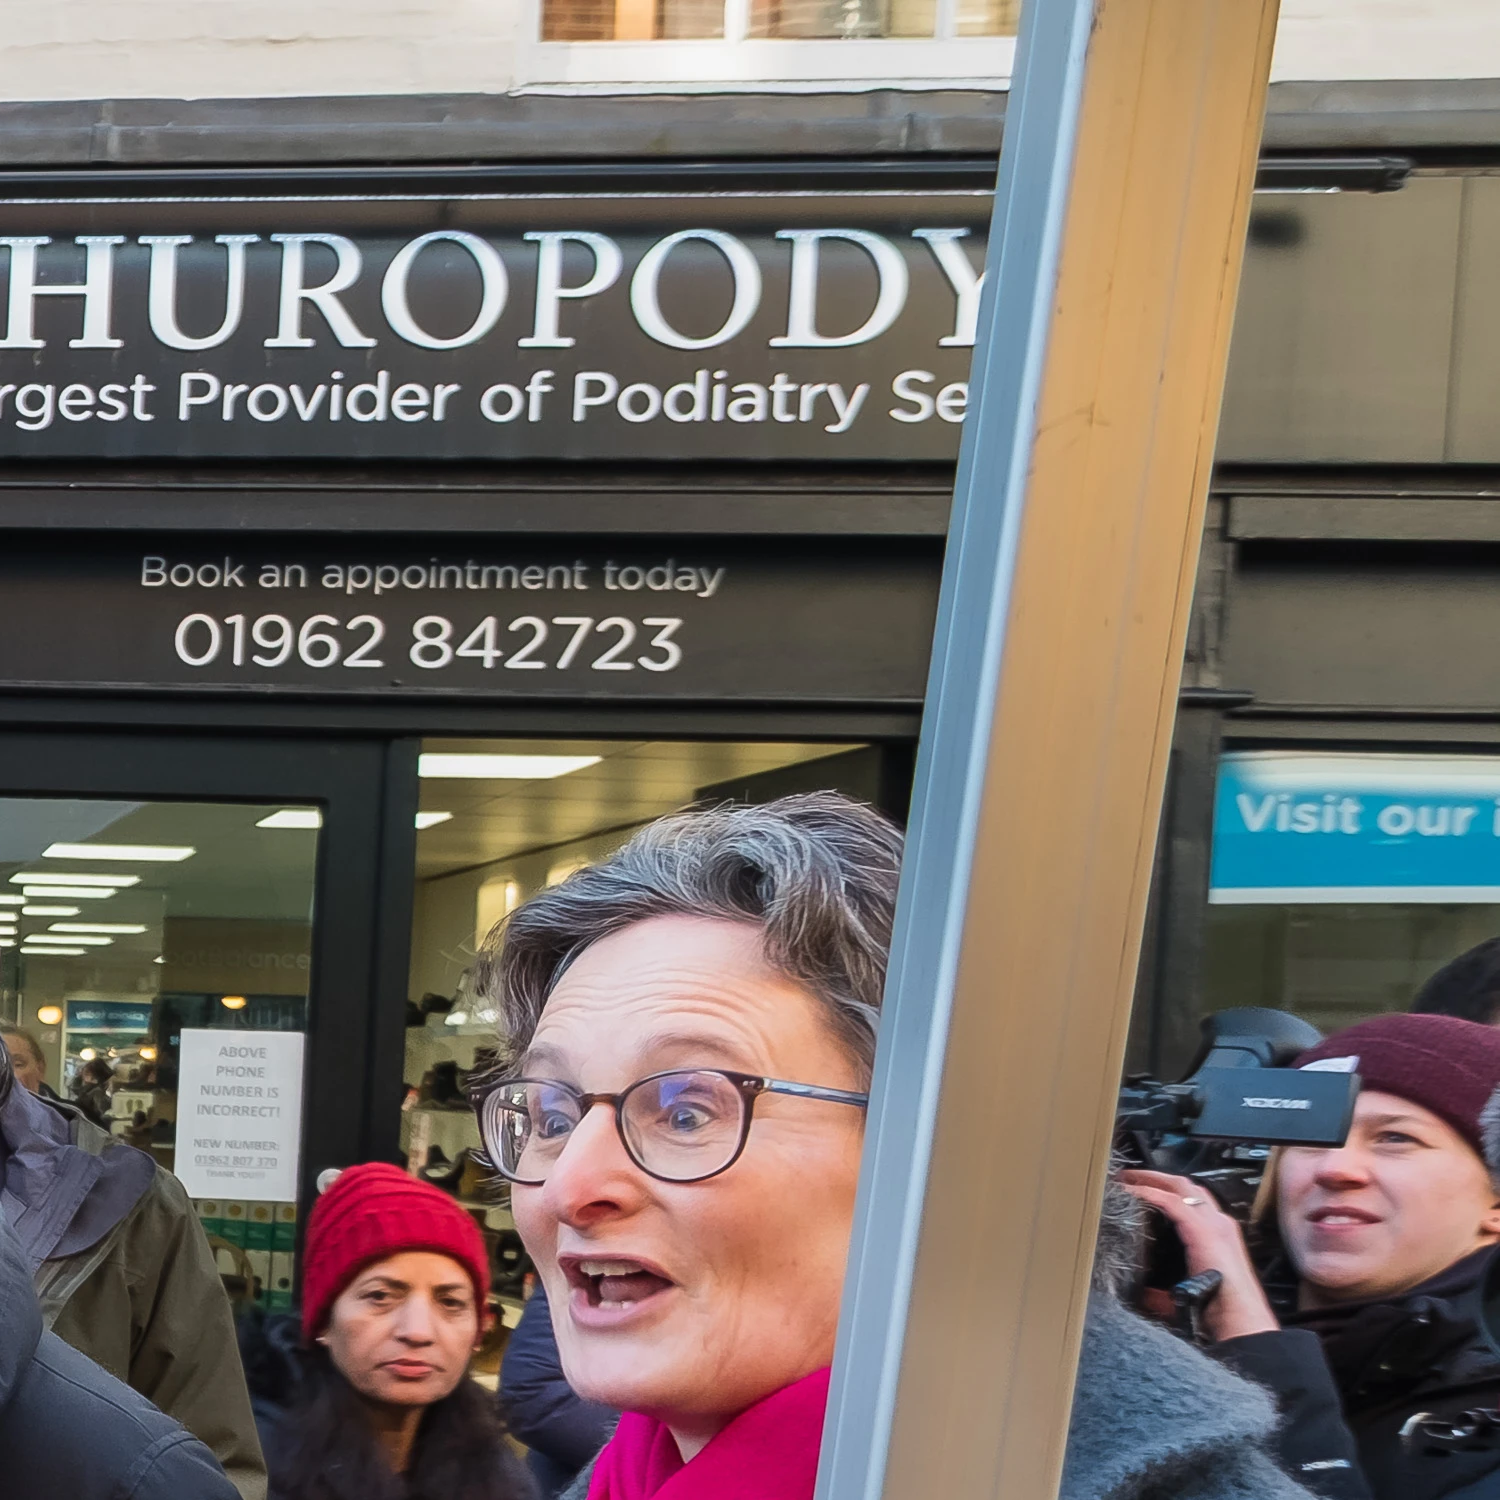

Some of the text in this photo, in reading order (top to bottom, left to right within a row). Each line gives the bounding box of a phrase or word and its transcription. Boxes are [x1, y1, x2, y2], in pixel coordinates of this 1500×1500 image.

[178, 370, 461, 422] Provider
[480, 369, 555, 423] of
[572, 369, 871, 433] Podiatry
[141, 556, 726, 598] Book an appointment today
[174, 613, 684, 672] 01962 842723
[1236, 792, 1364, 835] Visit
[1376, 803, 1480, 837] our
[218, 1046, 267, 1059] ABOVE
[216, 1065, 266, 1078] PHONE
[200, 1084, 280, 1099] NUMBER IS
[196, 1103, 281, 1118] INCORRECT!
[193, 1138, 281, 1151] NEW NUMBER:
[193, 1154, 230, 1166] 01962
[232, 1155, 254, 1167] 807
